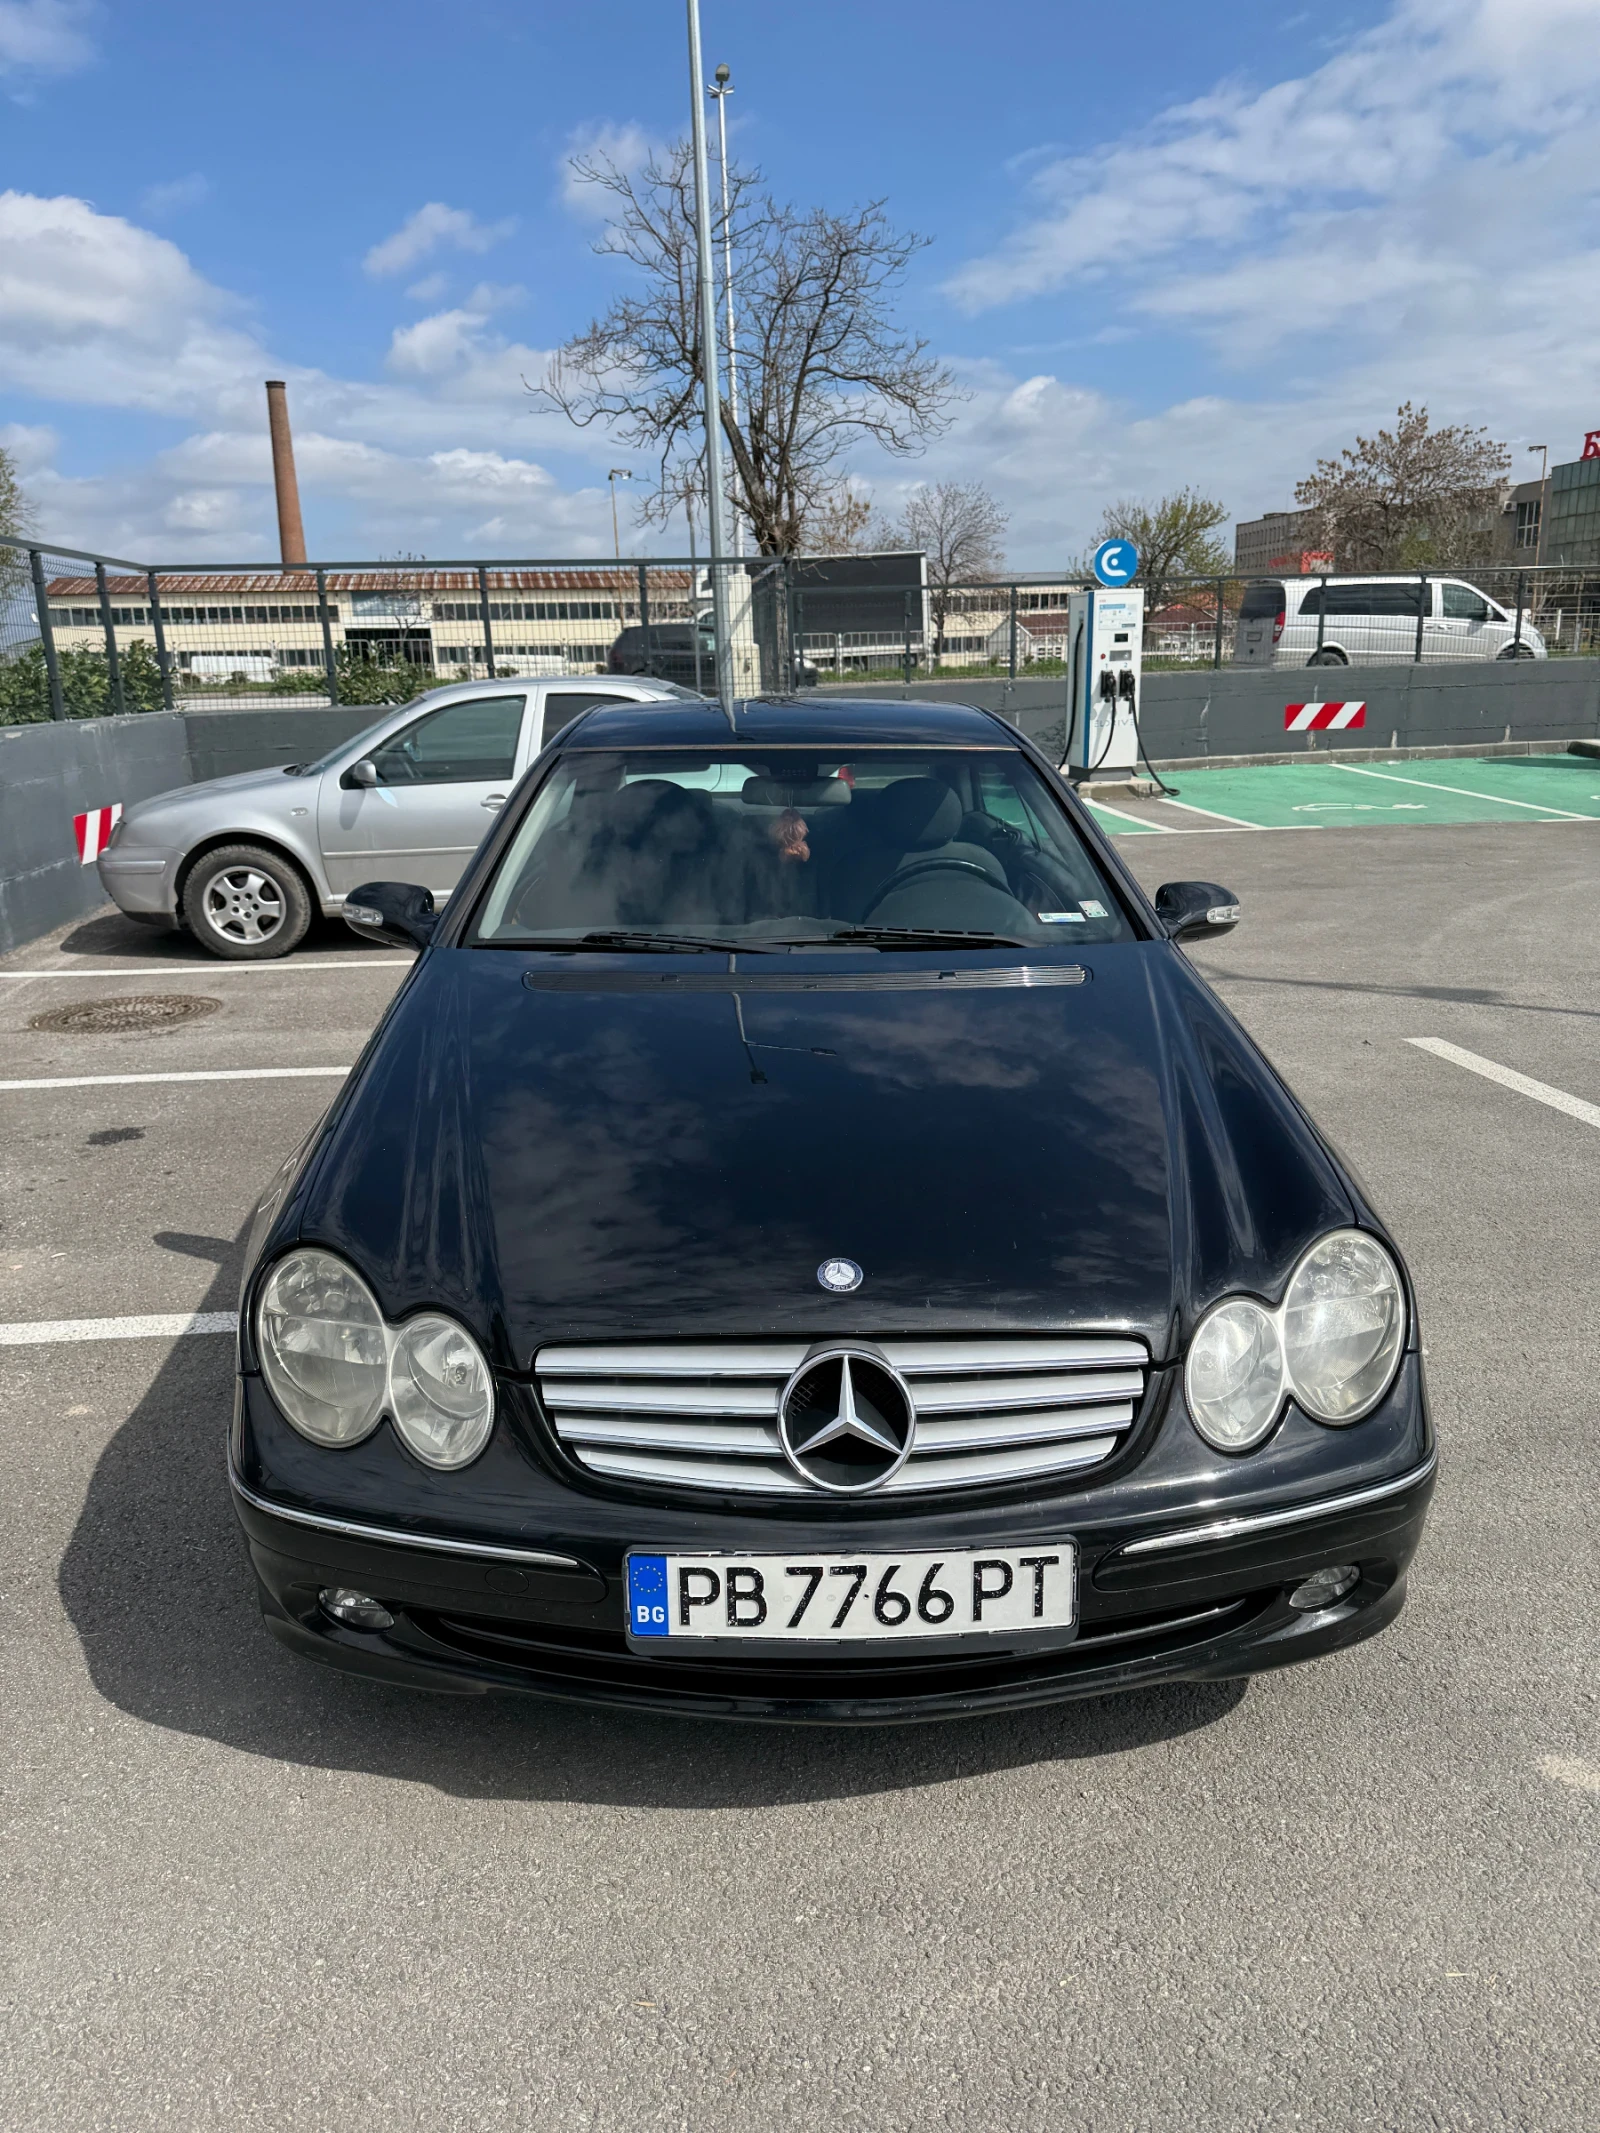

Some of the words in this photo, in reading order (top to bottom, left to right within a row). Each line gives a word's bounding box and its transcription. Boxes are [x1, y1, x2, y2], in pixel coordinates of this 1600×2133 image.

[1094, 719, 1135, 728] ELDIVE
[679, 1566, 767, 1627] PB
[785, 1562, 955, 1629] 7766
[972, 1555, 1060, 1622] PT
[637, 1605, 665, 1623] BG
